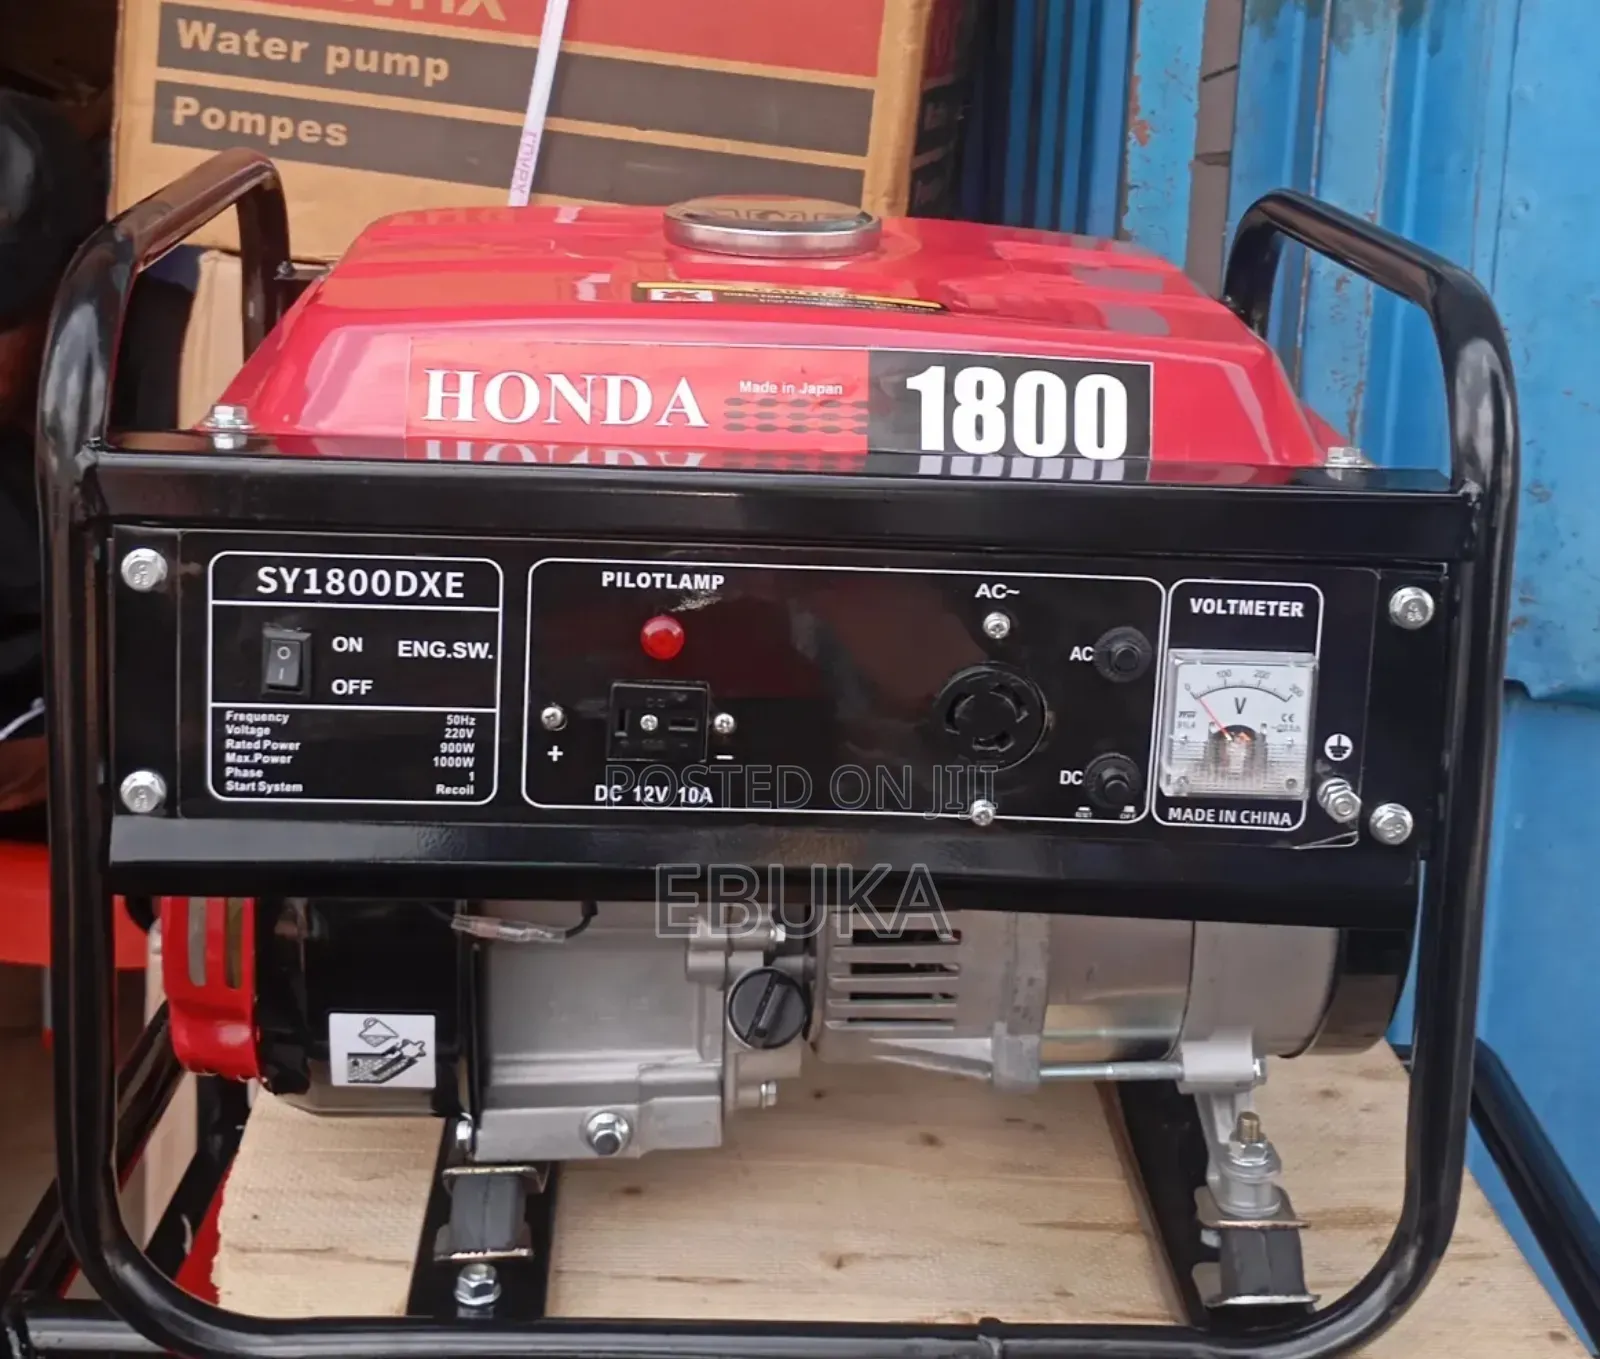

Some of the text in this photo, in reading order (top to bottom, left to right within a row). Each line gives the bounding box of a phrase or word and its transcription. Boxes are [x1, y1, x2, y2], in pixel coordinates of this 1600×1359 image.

[176, 18, 449, 87] Water pump
[173, 96, 348, 146] Pompes
[739, 381, 843, 397] Made in Japan
[421, 368, 709, 427] HONDA
[906, 364, 1128, 460] 1800
[256, 566, 464, 598] SY1800DXE
[601, 571, 725, 590] PILOTLAMP
[1189, 597, 1304, 617] VOLTMETER
[332, 636, 363, 652] ON
[1069, 646, 1094, 661] AC
[331, 679, 373, 694] OFF
[1234, 697, 1247, 715] V
[225, 710, 476, 726] Frequency 50Hz
[225, 724, 475, 739] Voltage 220V
[225, 739, 475, 753] Rated Power 900W
[433, 756, 475, 768] 1000W
[225, 767, 475, 782] Phase 1
[1059, 770, 1084, 785] DC
[225, 780, 474, 795] Start System Recoil
[594, 785, 713, 804] DC 12V 10A
[1168, 807, 1292, 826] MADE IN CHINA
